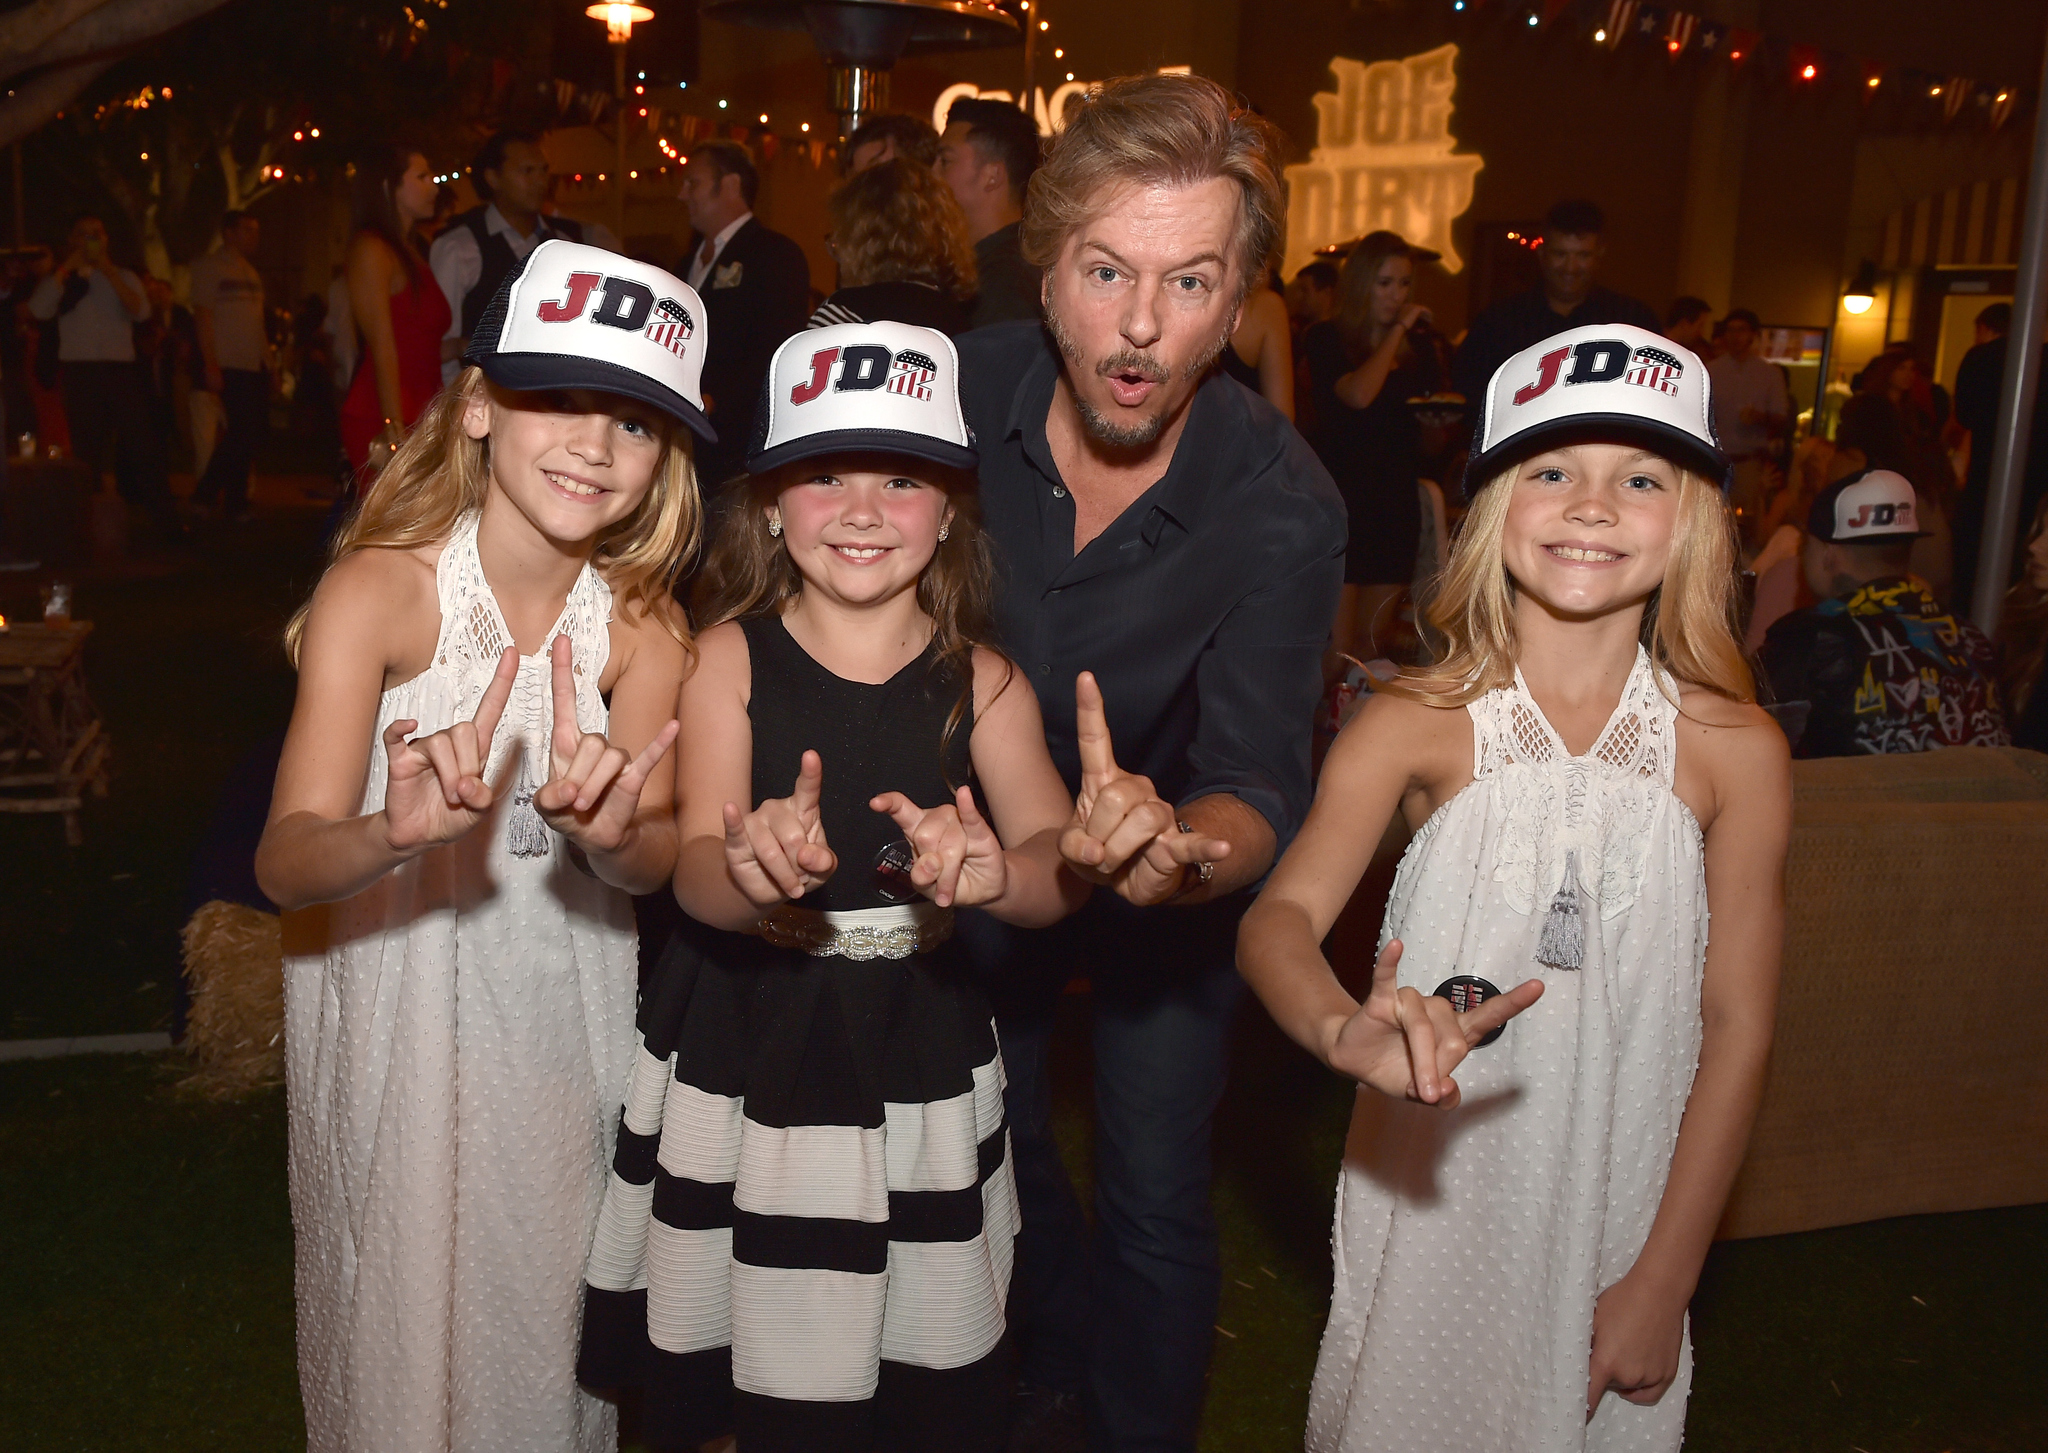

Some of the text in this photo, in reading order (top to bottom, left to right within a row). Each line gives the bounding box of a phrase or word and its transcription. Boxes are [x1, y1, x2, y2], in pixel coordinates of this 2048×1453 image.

[1313, 44, 1458, 149] JOE
[536, 272, 695, 358] JD2
[791, 344, 937, 406] JD2
[1512, 339, 1684, 406] JD2
